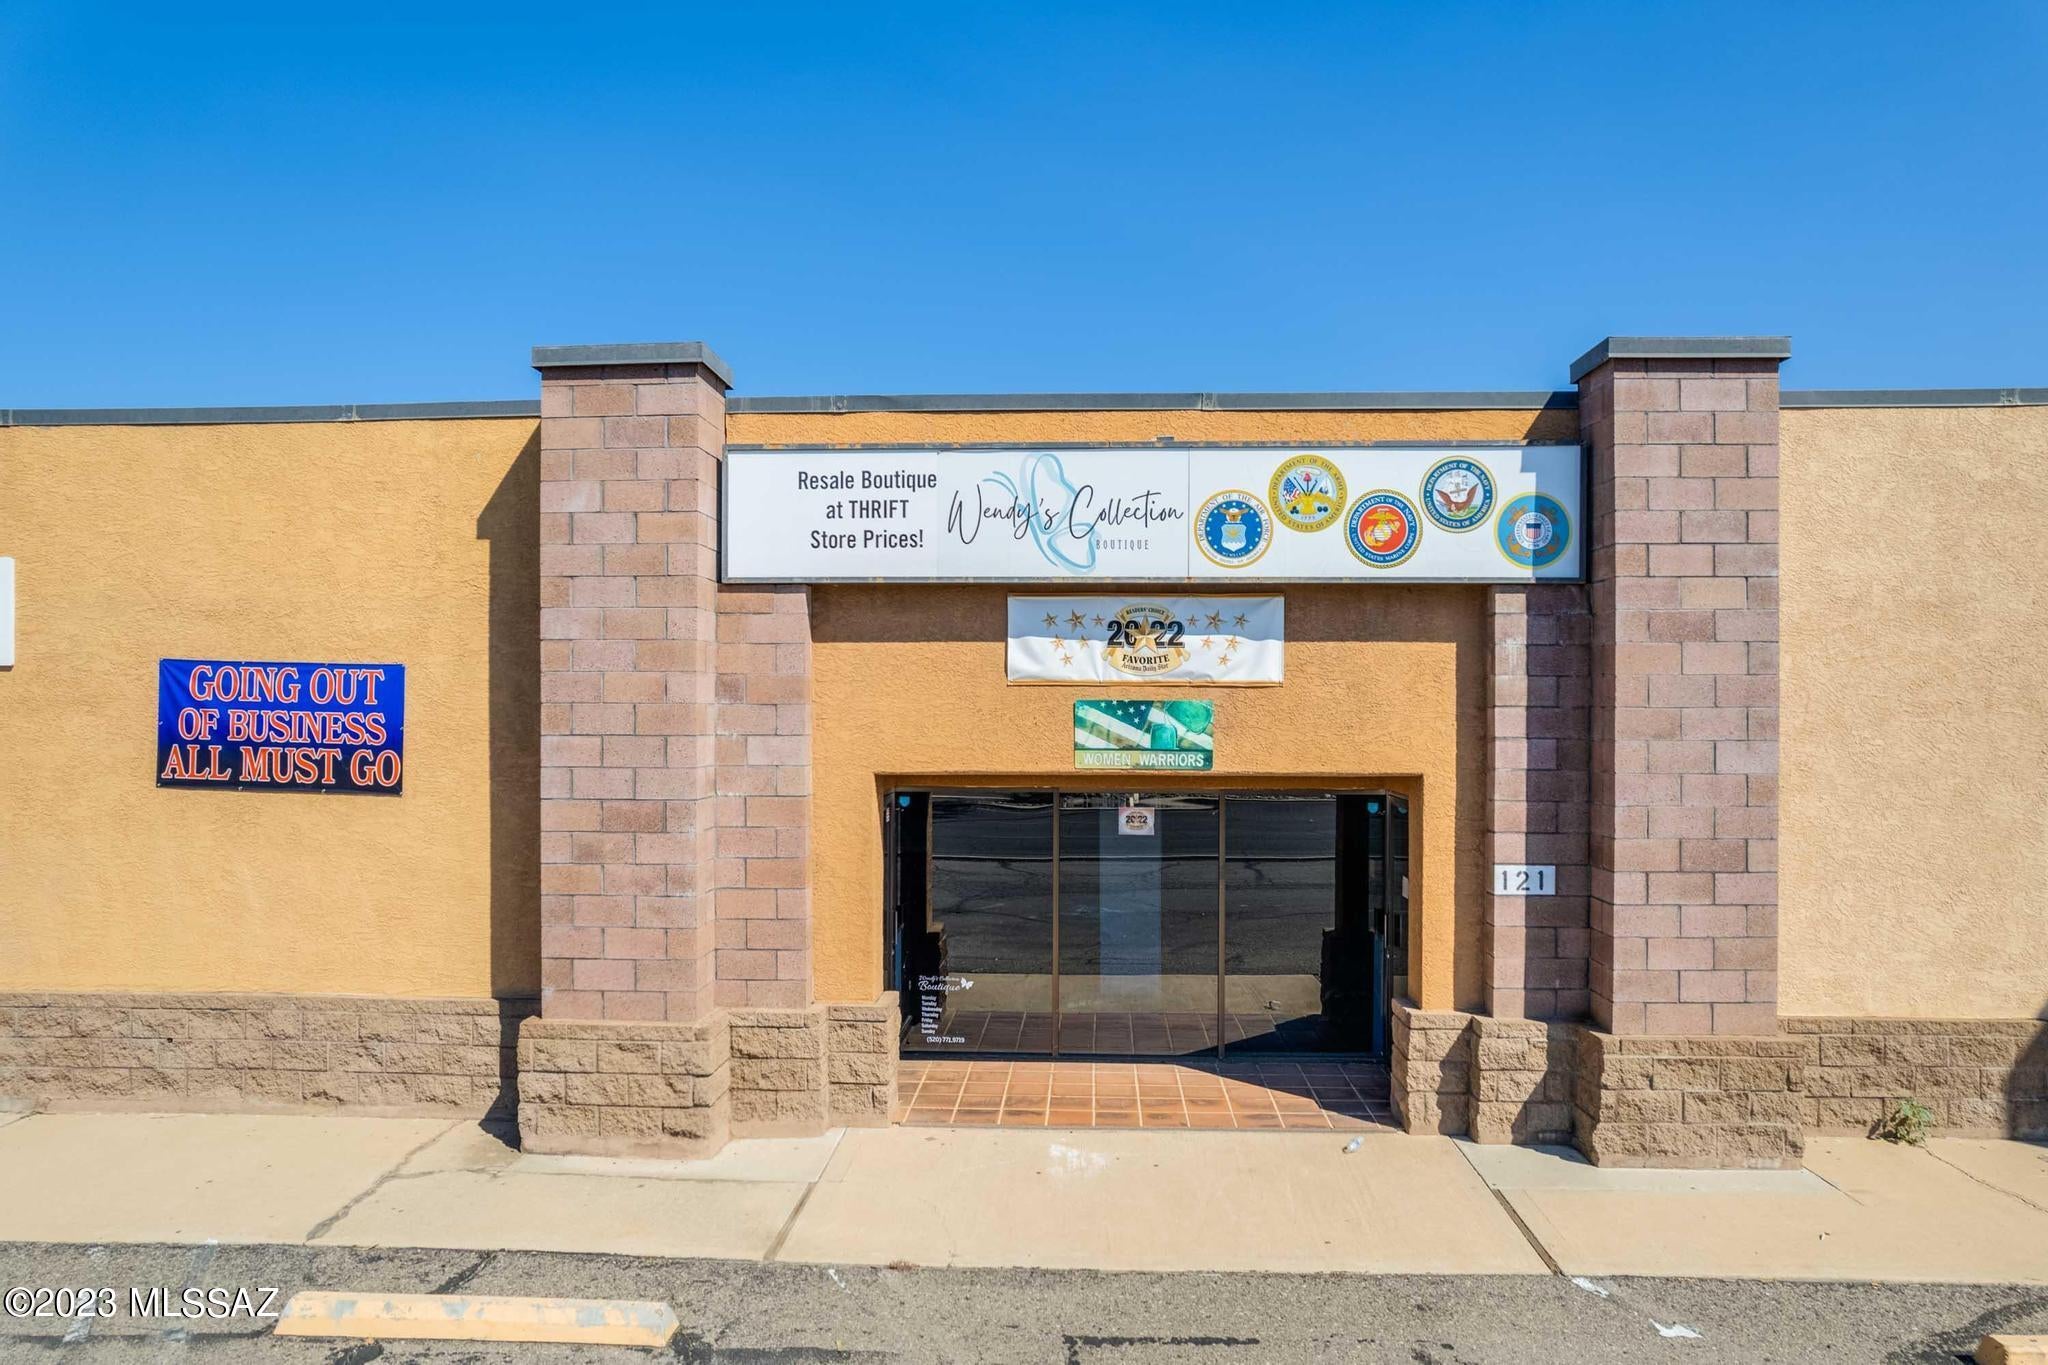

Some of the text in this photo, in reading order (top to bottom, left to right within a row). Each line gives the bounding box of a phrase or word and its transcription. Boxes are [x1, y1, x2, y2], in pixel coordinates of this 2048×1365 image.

[798, 470, 937, 493] Resale Boutique
[1272, 458, 1305, 490] DEPARTMENT
[1320, 461, 1333, 471] THE
[1334, 472, 1343, 491] ARMY
[1426, 462, 1458, 491] DEPARTMENT
[1470, 466, 1482, 475] THE
[826, 499, 909, 519] at THRIFT
[947, 484, 1184, 545] Wendy's Collection
[1198, 498, 1219, 542] DEPARTMENT
[1238, 494, 1252, 503] THE
[1254, 503, 1265, 516] AIR
[1272, 495, 1343, 530] UNITED STATES OF AMERICA
[1350, 496, 1386, 528] DEPARTMENT
[1393, 500, 1404, 509] THE
[1403, 508, 1416, 527] NAVY
[1426, 498, 1440, 519] UNITED
[1440, 518, 1462, 527] STATES
[1471, 499, 1491, 521] AMERICA
[810, 529, 924, 549] Store Prices!
[1095, 539, 1150, 550] BOUTIQUE
[1351, 533, 1366, 554] UNITED
[1148, 607, 1165, 615] CHOICE
[1106, 620, 1186, 648] 2022
[1122, 654, 1170, 664] FAVORITE
[188, 664, 385, 705] GOING OUT
[178, 707, 388, 746] OF BUSINESS
[161, 743, 401, 787] ALL MUST GO
[1082, 753, 1205, 767] WOMEN WARRIORS
[1125, 815, 1148, 824] 2022
[1502, 870, 1544, 891] 121
[918, 980, 960, 995] Boutique
